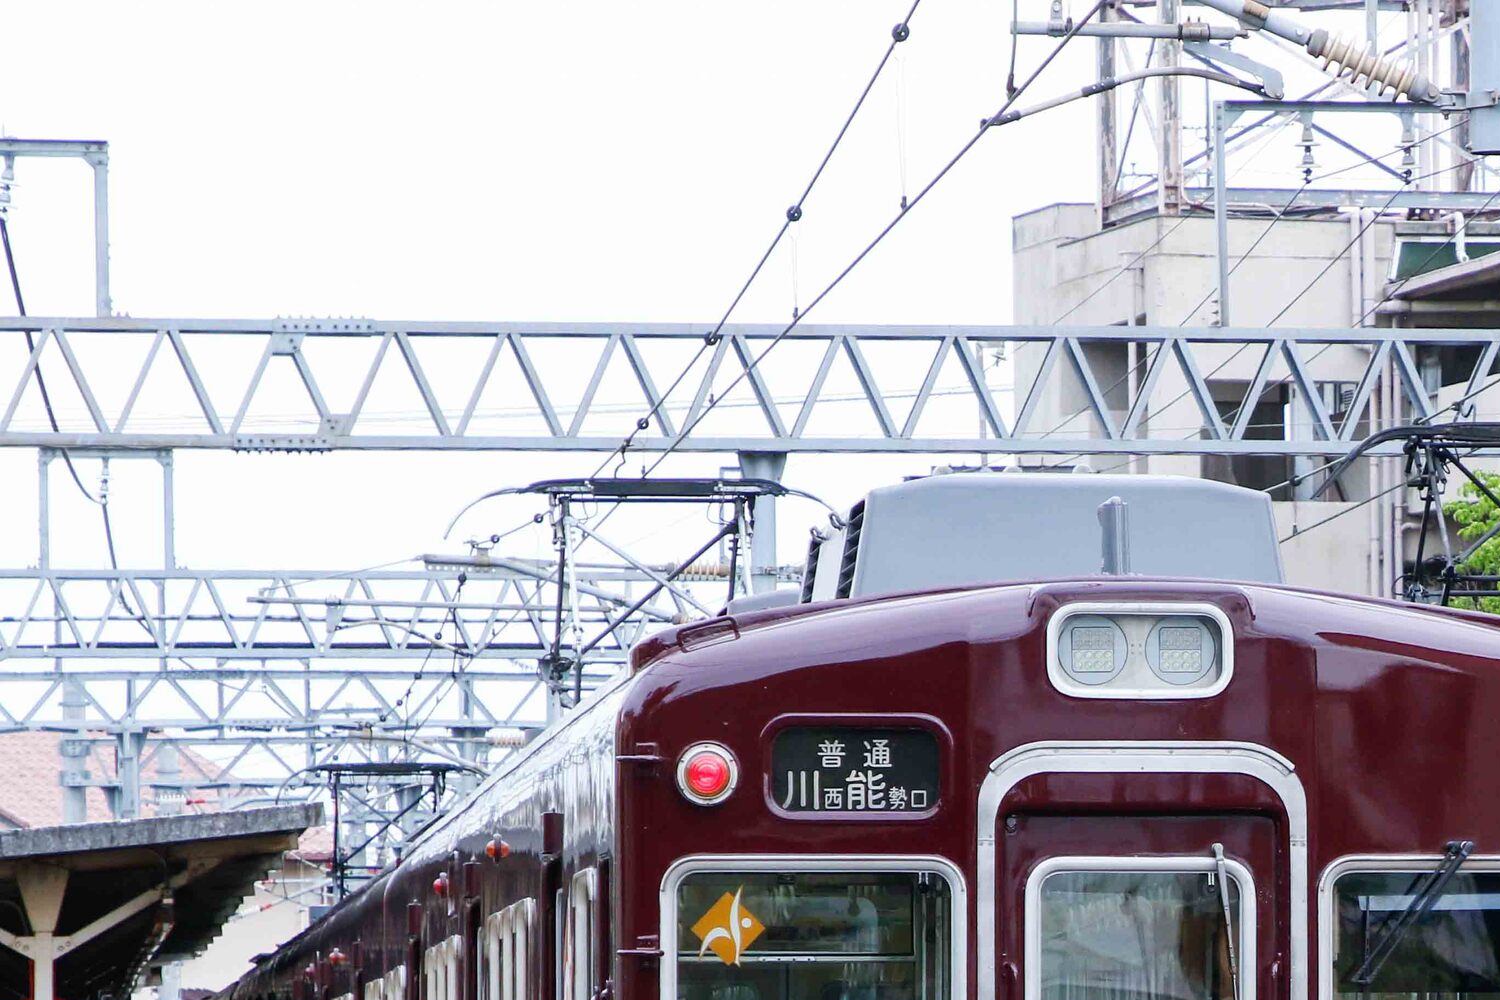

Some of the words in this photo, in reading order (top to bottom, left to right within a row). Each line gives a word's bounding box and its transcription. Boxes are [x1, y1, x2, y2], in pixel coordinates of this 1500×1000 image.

[817, 739, 893, 769] 普通
[782, 769, 928, 810] 川西能勢口
